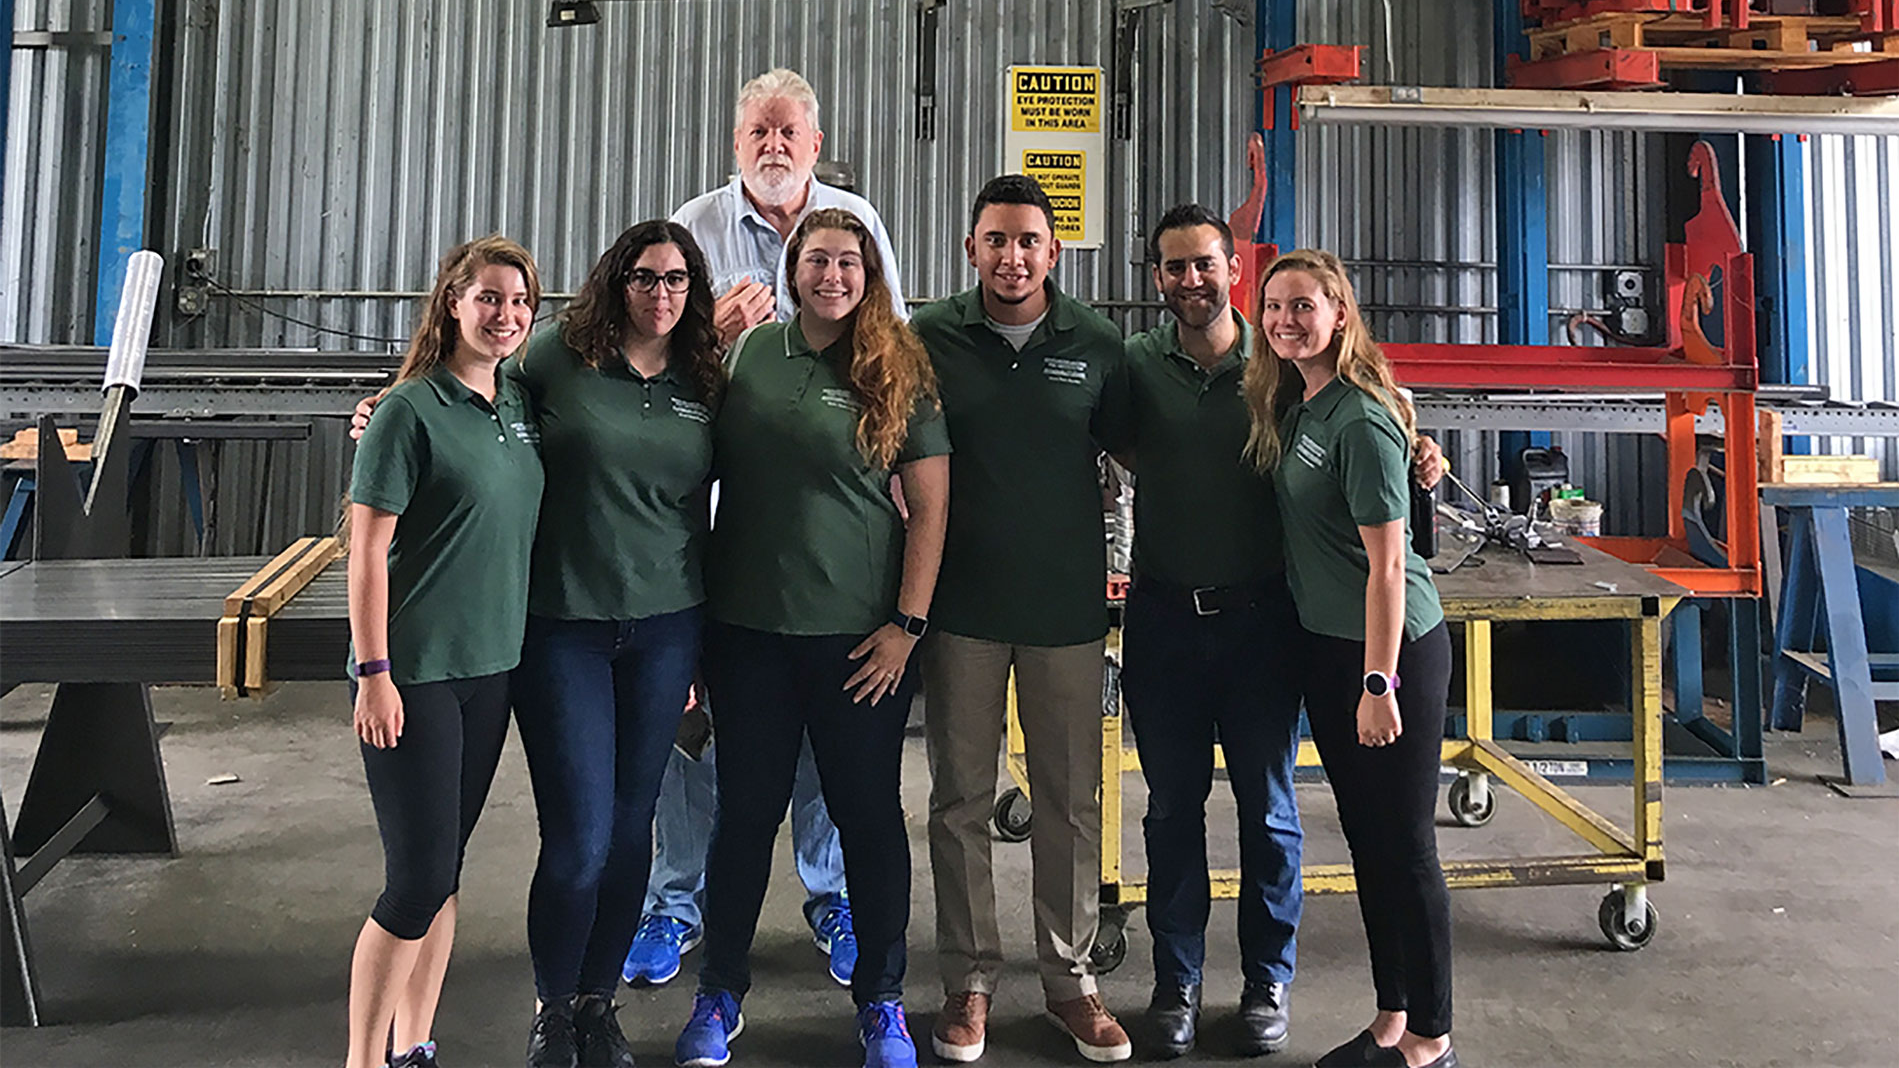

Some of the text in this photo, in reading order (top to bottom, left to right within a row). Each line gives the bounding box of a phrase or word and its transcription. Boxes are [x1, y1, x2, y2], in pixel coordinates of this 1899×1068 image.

[1018, 75, 1095, 91] CAUTION
[1017, 96, 1095, 106] EYE PROTECTION
[1021, 107, 1091, 117] MUST BE WORN
[1025, 118, 1036, 127] IN
[1038, 118, 1060, 127] THIS
[1062, 119, 1086, 128] AREA
[1027, 155, 1080, 167] CAUTION
